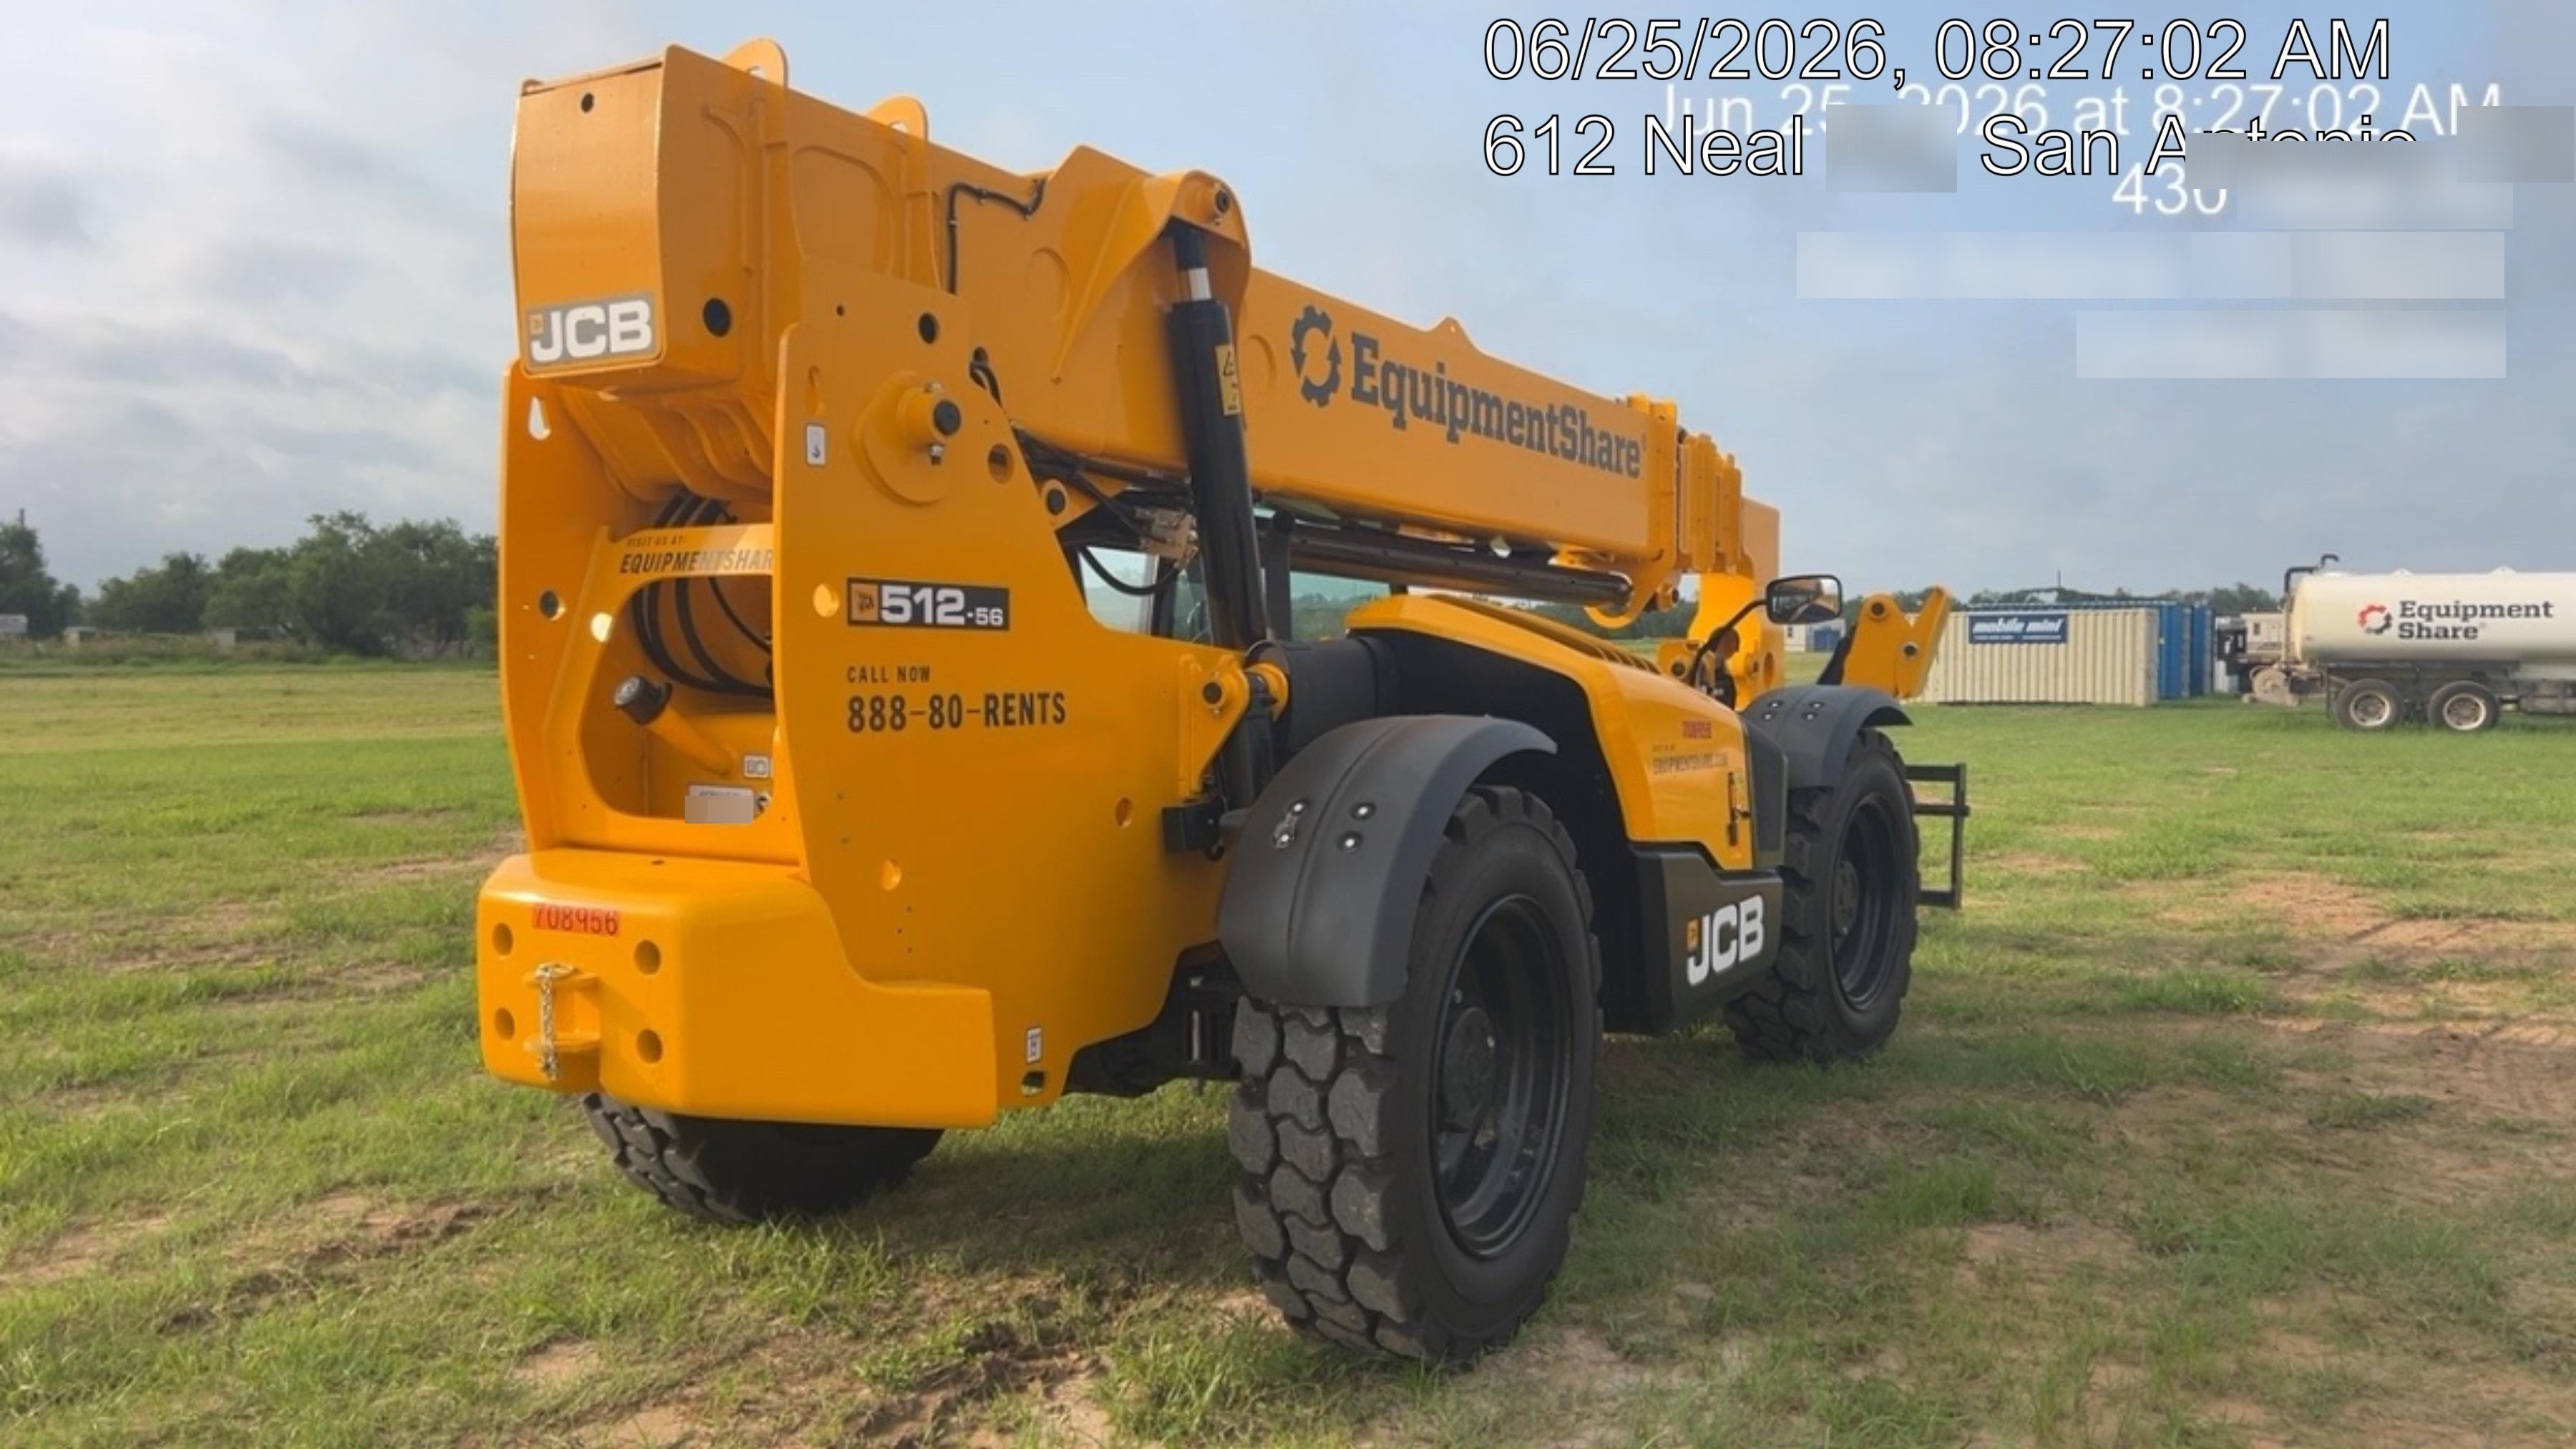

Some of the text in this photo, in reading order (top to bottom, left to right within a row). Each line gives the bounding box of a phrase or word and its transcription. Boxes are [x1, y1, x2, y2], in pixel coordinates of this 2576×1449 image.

[531, 300, 652, 362] JCB
[2399, 600, 2554, 622] Equipment
[2398, 621, 2479, 640] Share
[848, 665, 931, 683] CALL NOW
[848, 691, 1066, 733] 888-80-RENTS
[535, 903, 618, 937] 708956
[1687, 894, 1765, 986] JCB
